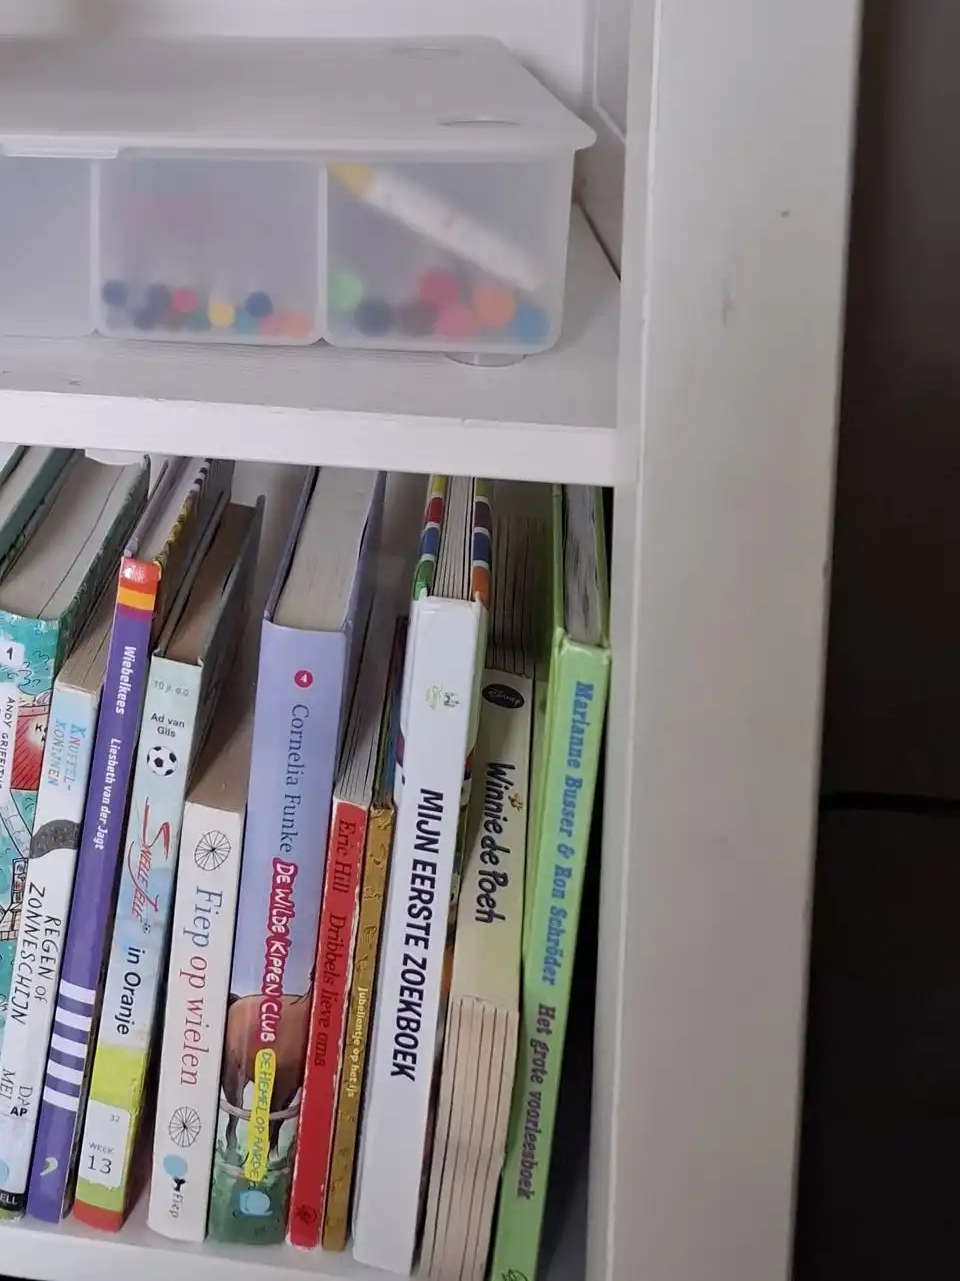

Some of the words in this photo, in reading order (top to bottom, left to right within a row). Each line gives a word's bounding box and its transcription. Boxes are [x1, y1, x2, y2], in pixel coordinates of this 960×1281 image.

[6, 647, 14, 660] 1
[115, 645, 137, 715] Wiebelkees
[4, 697, 16, 730] ANDY
[150, 712, 164, 723] Ad
[167, 718, 185, 728] van
[156, 726, 176, 738] Gils
[567, 680, 595, 769] Marianne
[104, 738, 122, 785] Liesbeth
[284, 703, 310, 786] Cornelia
[98, 806, 112, 826] der
[101, 786, 113, 805] van
[484, 762, 516, 834] Winnie
[559, 774, 583, 838] Busser
[93, 826, 109, 850] Jagt
[278, 793, 303, 854] Funke
[337, 820, 356, 856] Eric
[413, 788, 444, 854] MIJN
[136, 796, 171, 889] SNELLE
[480, 835, 511, 865] de
[557, 843, 575, 860] &
[276, 862, 294, 884] DE
[333, 862, 352, 893] Hill
[552, 864, 573, 899] Ron
[183, 885, 223, 948] Fiep
[272, 888, 293, 934] WILDE
[403, 858, 437, 950] EERSTE
[475, 869, 509, 924] Poeh
[9, 881, 46, 1025] ZONNESCHIJN
[37, 915, 62, 980] REGEN
[128, 946, 146, 965] in
[323, 914, 346, 985] Dribbels
[542, 905, 568, 986] Schröder
[180, 956, 207, 989] op
[264, 940, 287, 996] KIPPEN
[114, 972, 141, 1035] Oranje
[260, 1003, 279, 1043] CLUB
[319, 988, 339, 1029] lieve
[391, 952, 429, 1083] ZOEKBOEK
[536, 1002, 556, 1036] Het
[180, 998, 210, 1086] wielen
[315, 1033, 328, 1067] oma
[350, 1048, 361, 1062] op
[530, 1038, 550, 1085] grote
[349, 1064, 360, 1083] het
[10, 1106, 29, 1117] AP
[86, 1154, 113, 1175] 13
[88, 1141, 115, 1155] WEEK
[517, 1091, 542, 1200] voorleesboek
